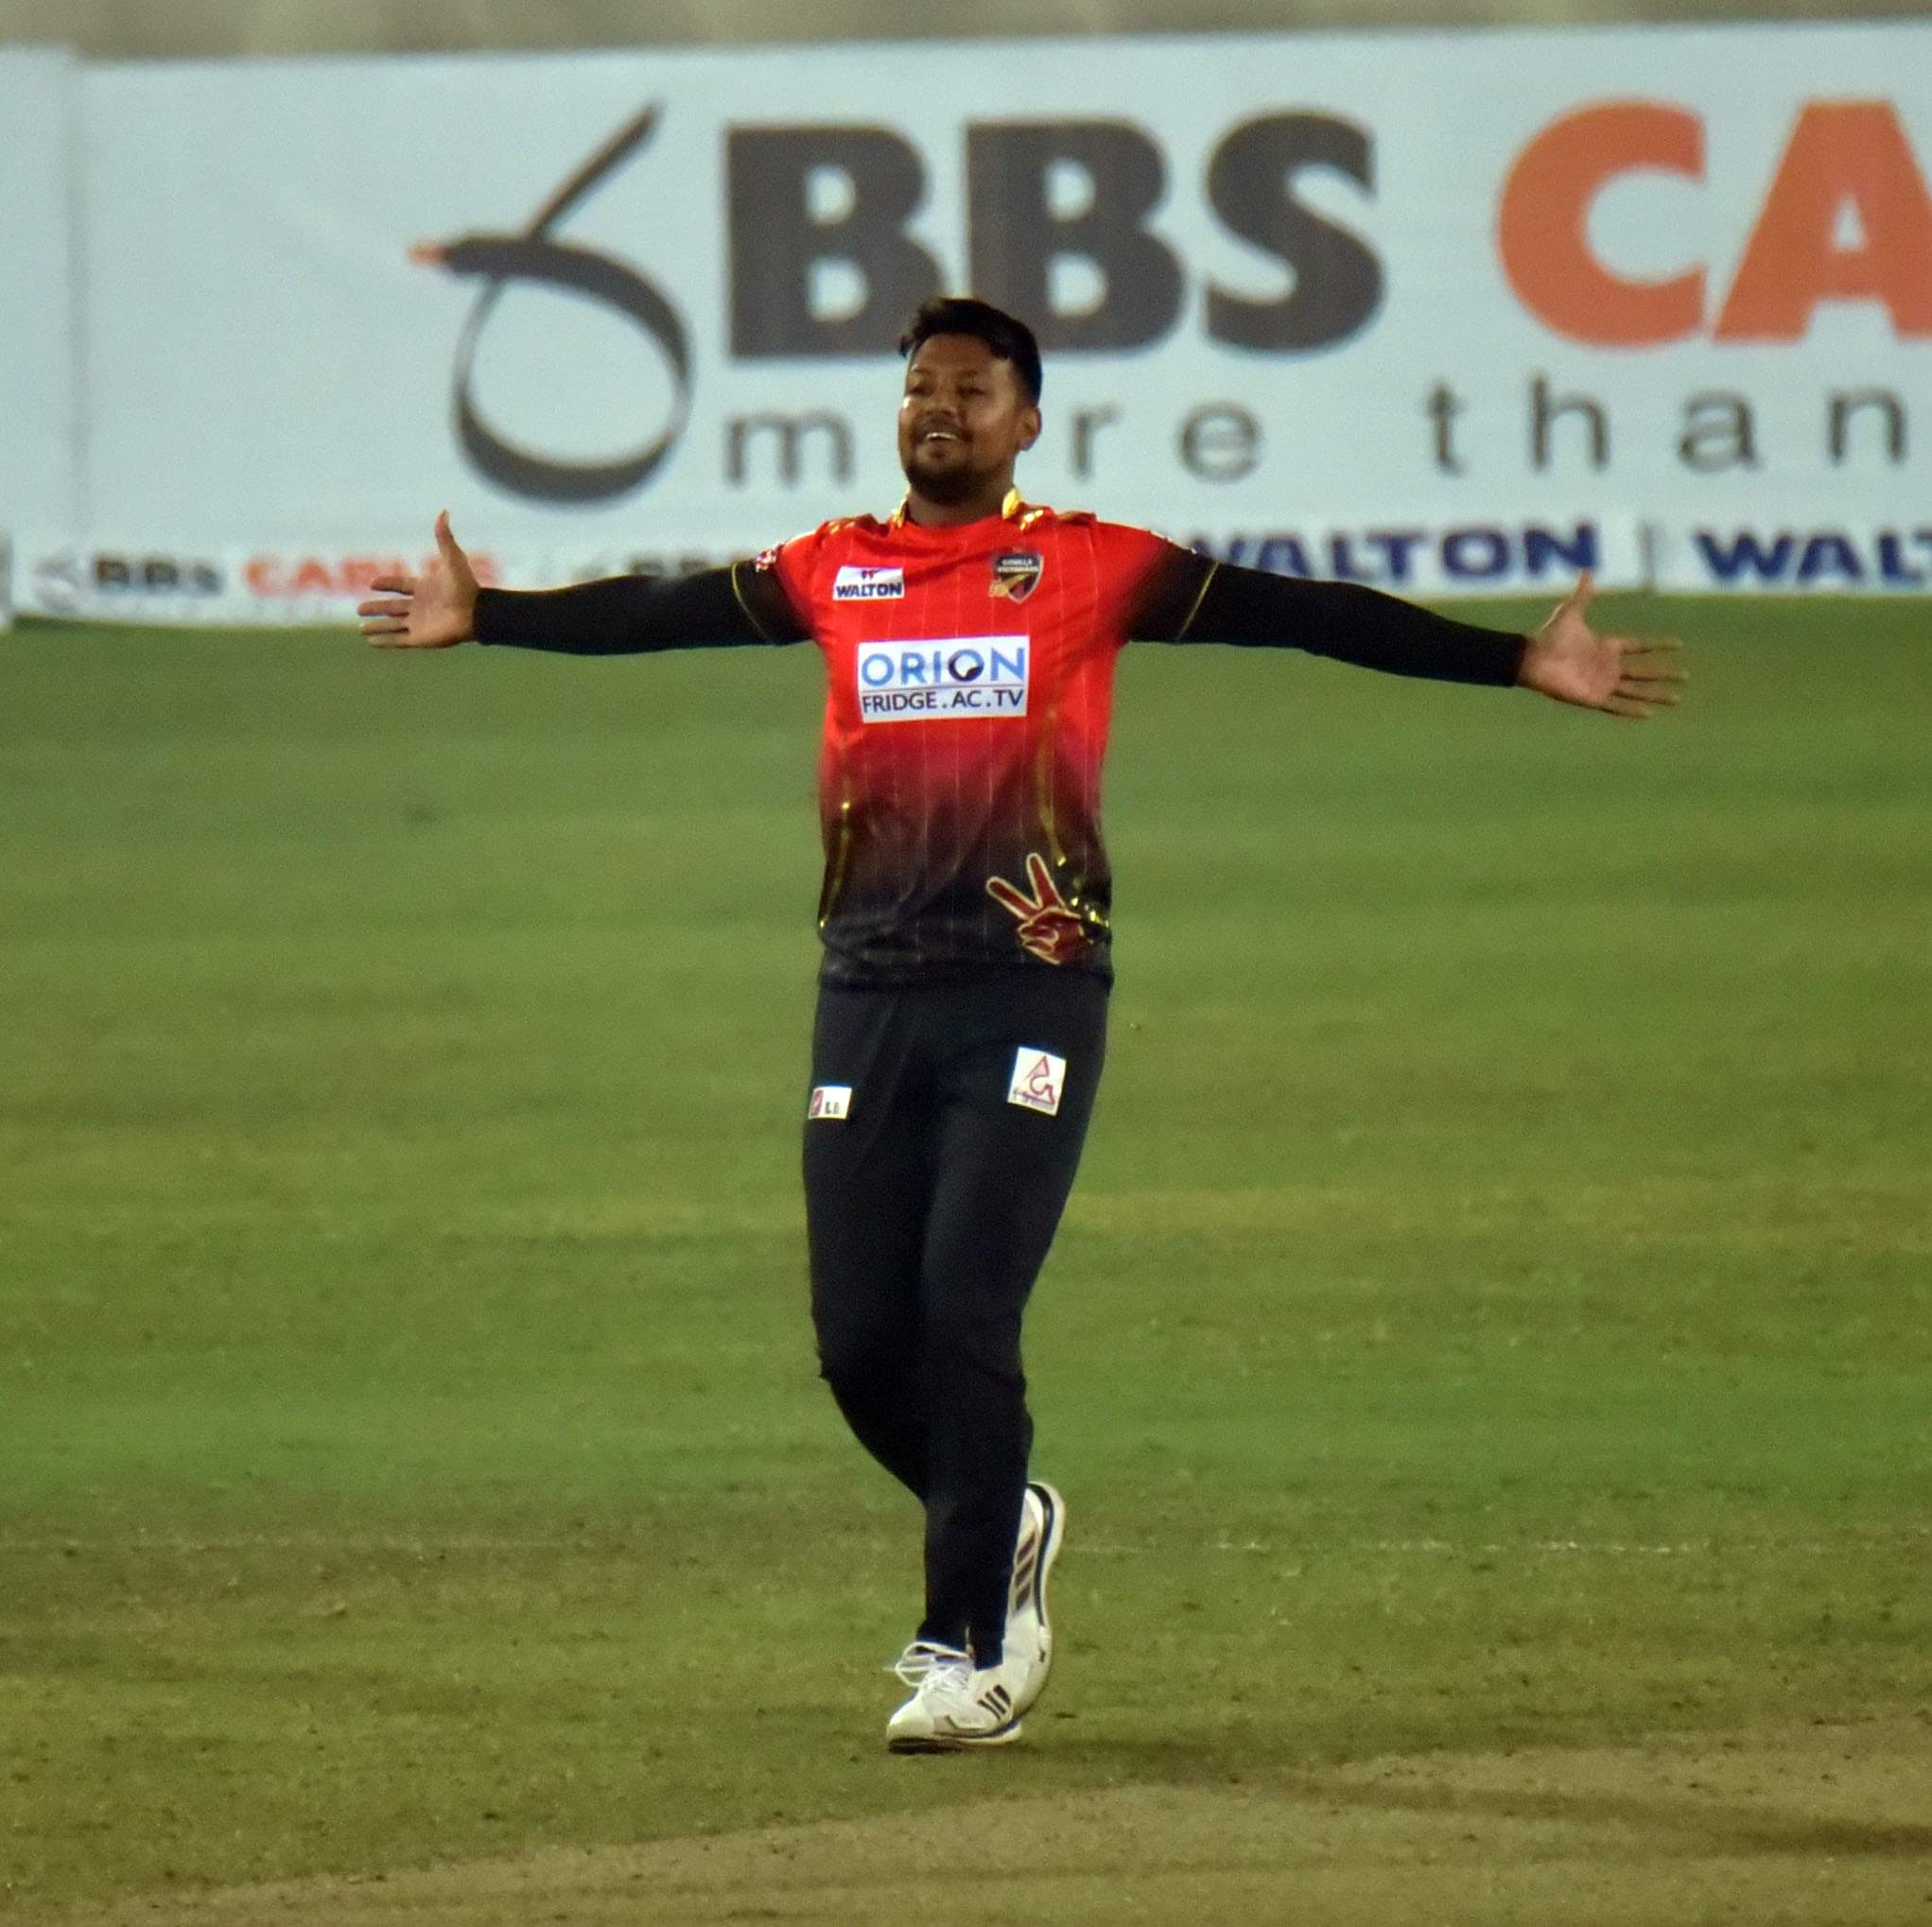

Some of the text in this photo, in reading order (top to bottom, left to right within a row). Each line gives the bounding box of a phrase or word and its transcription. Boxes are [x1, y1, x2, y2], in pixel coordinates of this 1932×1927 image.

[725, 113, 1385, 356] BBS
[725, 374, 1906, 485] mre than
[836, 582, 903, 599] WALTON
[862, 648, 1025, 687] ORION
